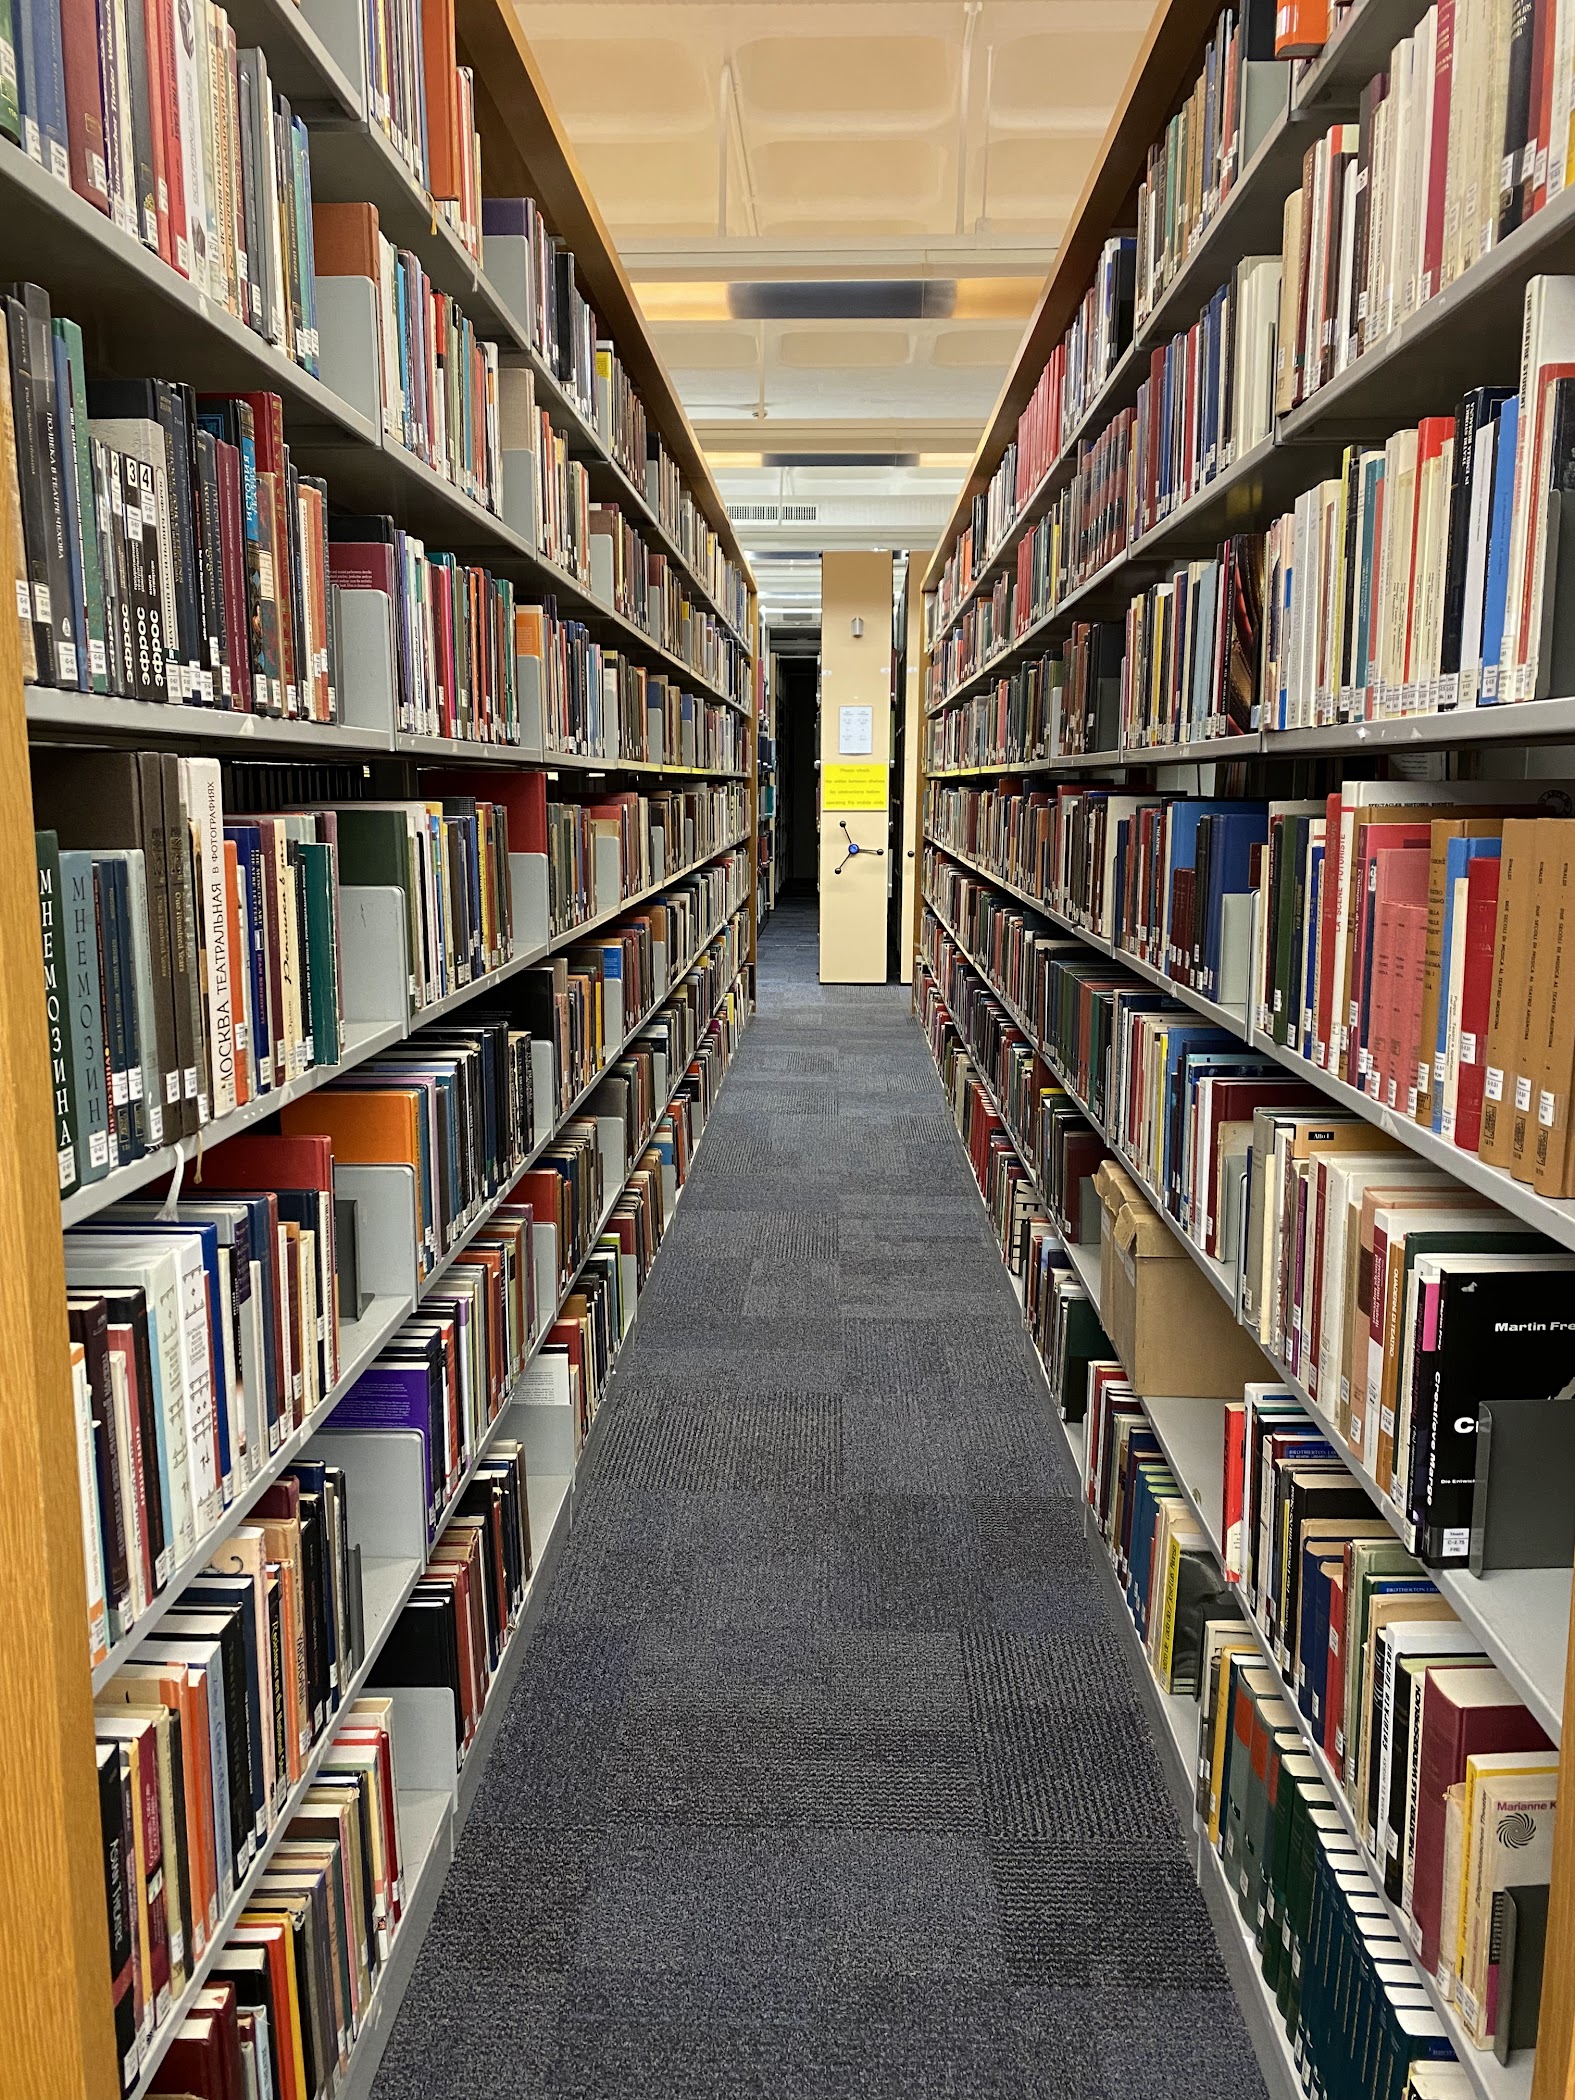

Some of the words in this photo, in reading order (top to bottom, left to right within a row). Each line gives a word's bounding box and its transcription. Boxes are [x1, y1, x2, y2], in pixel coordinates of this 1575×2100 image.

[107, 65, 116, 111] Tiroler
[217, 169, 221, 185] НА
[224, 171, 229, 188] НА
[1521, 315, 1531, 359] THEATRE
[1520, 363, 1528, 409] STUDENT
[113, 456, 118, 476] 2
[130, 462, 135, 483] 3
[142, 468, 149, 487] 4
[243, 454, 252, 521] ИСТОРИЯ
[54, 516, 64, 559] ЧЕХОВА
[122, 603, 133, 683] эфрос
[137, 607, 150, 685] эфрос
[150, 610, 163, 687] эфрос
[207, 782, 218, 862] ФОТОГРАФИЯХ
[1336, 834, 1345, 880] FUTURISTE
[173, 891, 182, 910] One
[157, 915, 166, 953] Hundred
[174, 911, 185, 949] Hundred
[211, 883, 228, 995] ТЕАТРАЛЬНАЯ
[1333, 921, 1340, 932] LA
[177, 950, 186, 972] Years
[39, 869, 72, 1146] МНЕМОЗИНА
[72, 876, 101, 1133] МНЕМОЗИН
[217, 1000, 233, 1089] МОСКВА
[1389, 1323, 1397, 1357] TEATRO
[1414, 1302, 1423, 1353] Migration
[1495, 1322, 1546, 1332] Martin
[1550, 1322, 1575, 1331] Fre
[1410, 1380, 1420, 1419] Theater
[271, 1616, 280, 1677] Resistance
[1411, 1683, 1421, 1779] WIDERSPRUCH
[1496, 1801, 1548, 1811] Marianne
[1407, 1804, 1416, 1859] THEATER
